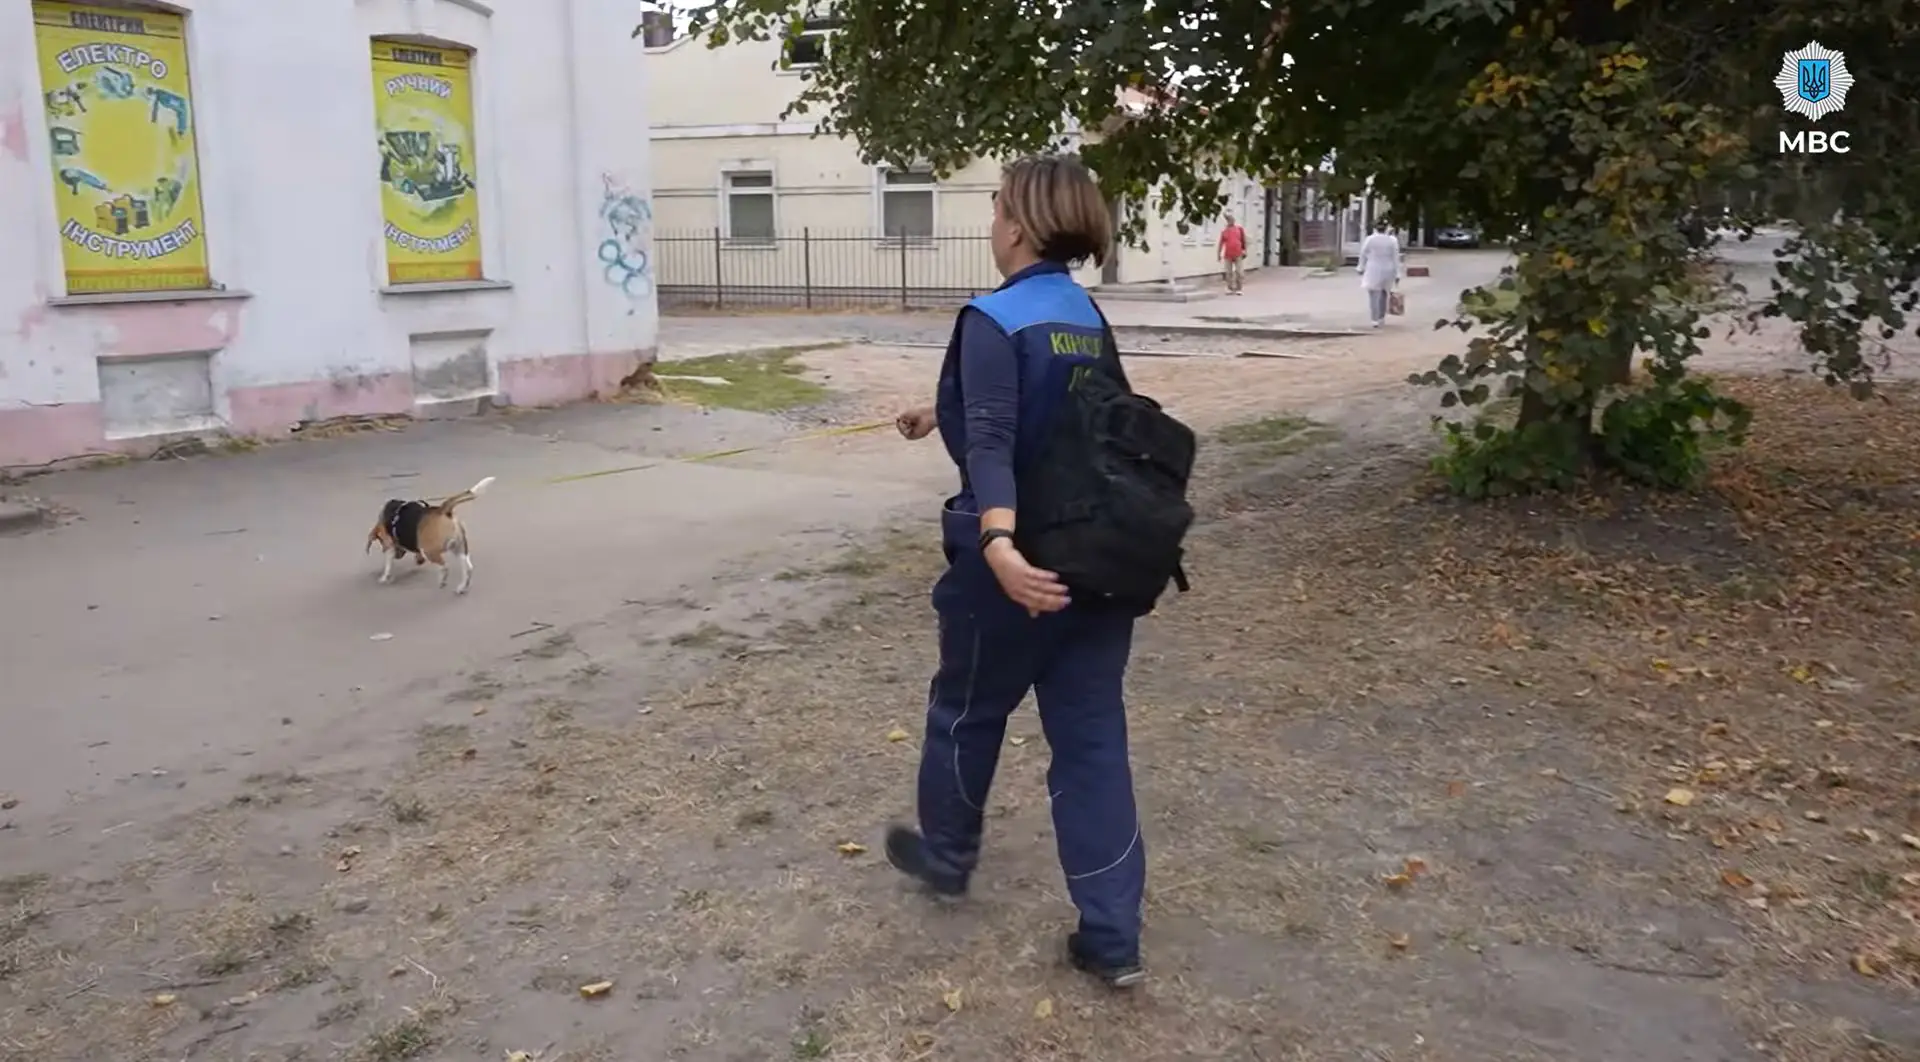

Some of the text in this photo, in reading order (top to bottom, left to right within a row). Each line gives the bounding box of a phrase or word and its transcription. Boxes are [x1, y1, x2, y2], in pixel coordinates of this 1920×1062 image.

[57, 43, 168, 79] ЕЛЕКТРО
[385, 73, 453, 98] РУЧНИЙ
[61, 218, 198, 260] ІНСТРУМЕНТ
[383, 220, 474, 254] ІНСТРУМЕНТ
